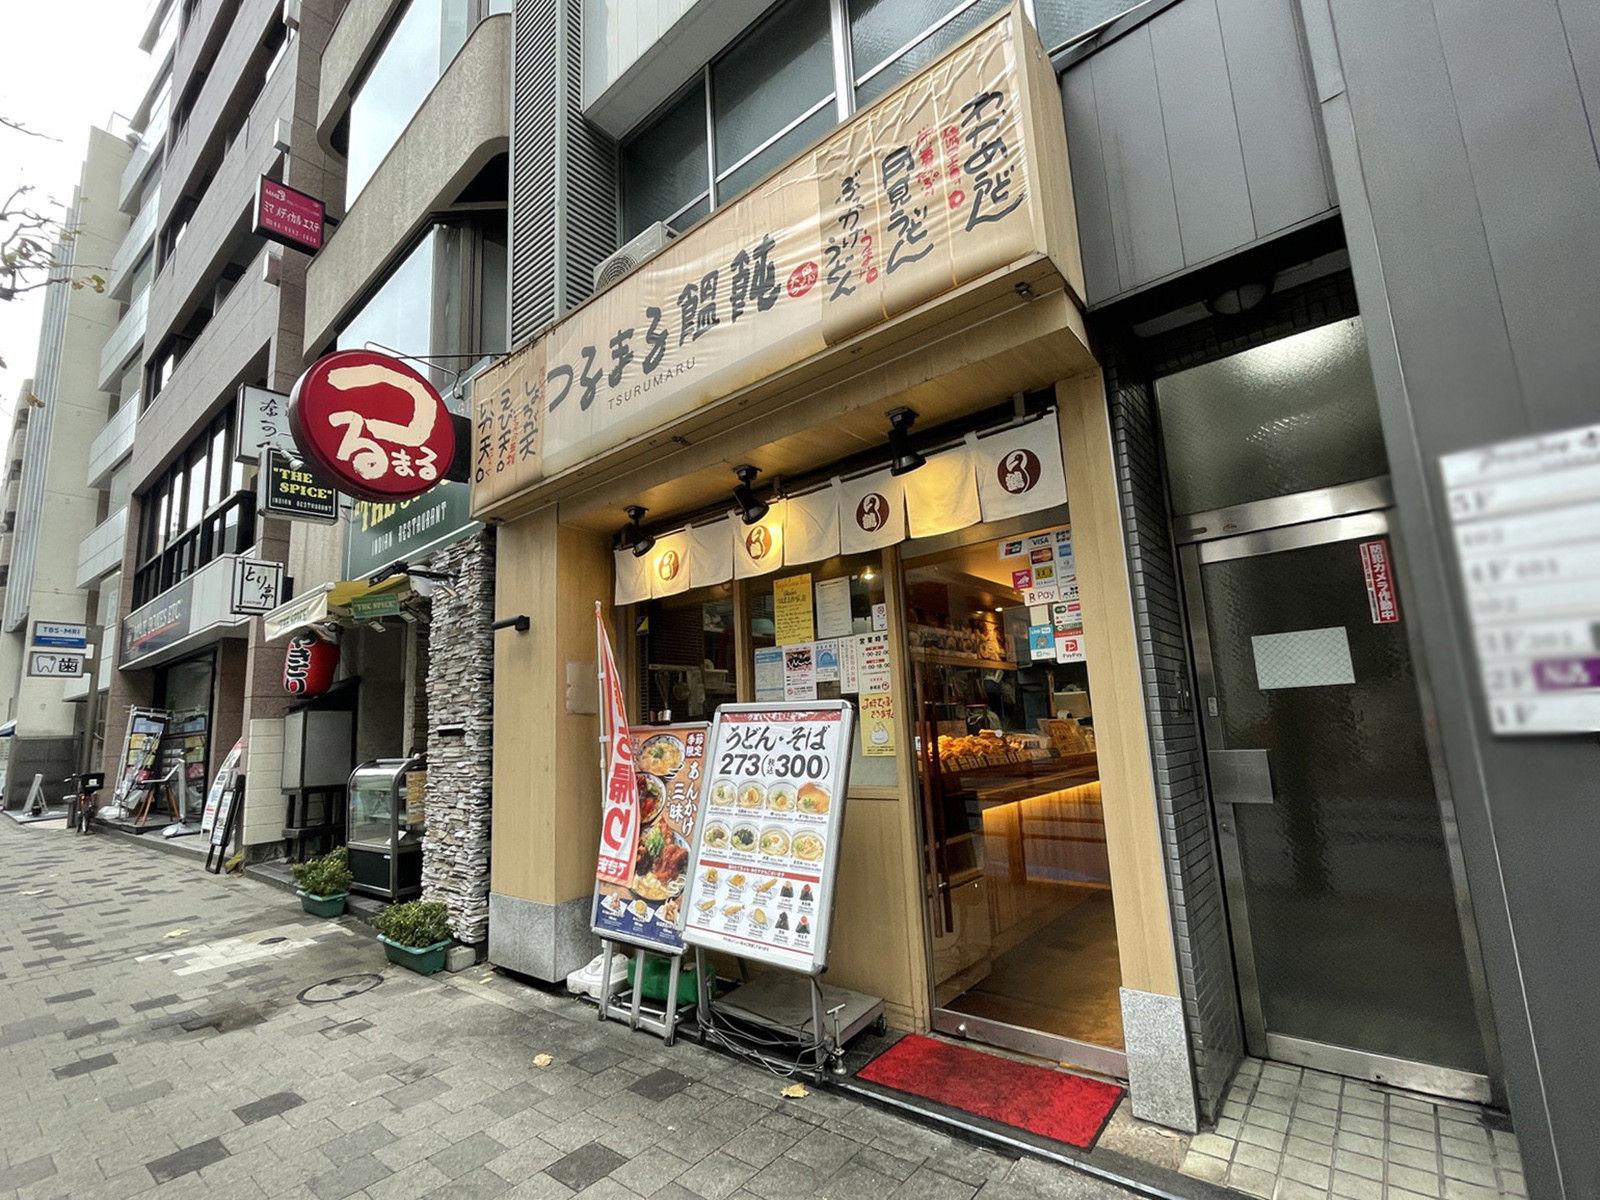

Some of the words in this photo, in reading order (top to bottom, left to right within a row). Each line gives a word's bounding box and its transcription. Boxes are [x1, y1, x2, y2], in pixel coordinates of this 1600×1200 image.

[882, 145, 934, 275] 月見うどん
[547, 233, 782, 414] つるまる饂飩
[607, 355, 697, 411] TSURUMARU
[327, 364, 437, 480] つるまる
[371, 530, 393, 557] INDIAN
[398, 501, 447, 544] RESTAURANT
[1032, 537, 1050, 546] VISA
[245, 566, 275, 607] とり亭
[1037, 590, 1055, 601] Pay
[43, 626, 81, 635] TBS-MRI
[686, 732, 704, 745] 季節
[726, 725, 831, 752] うどん・そば
[668, 782, 686, 823] 三昧
[681, 760, 700, 837] あんかけ
